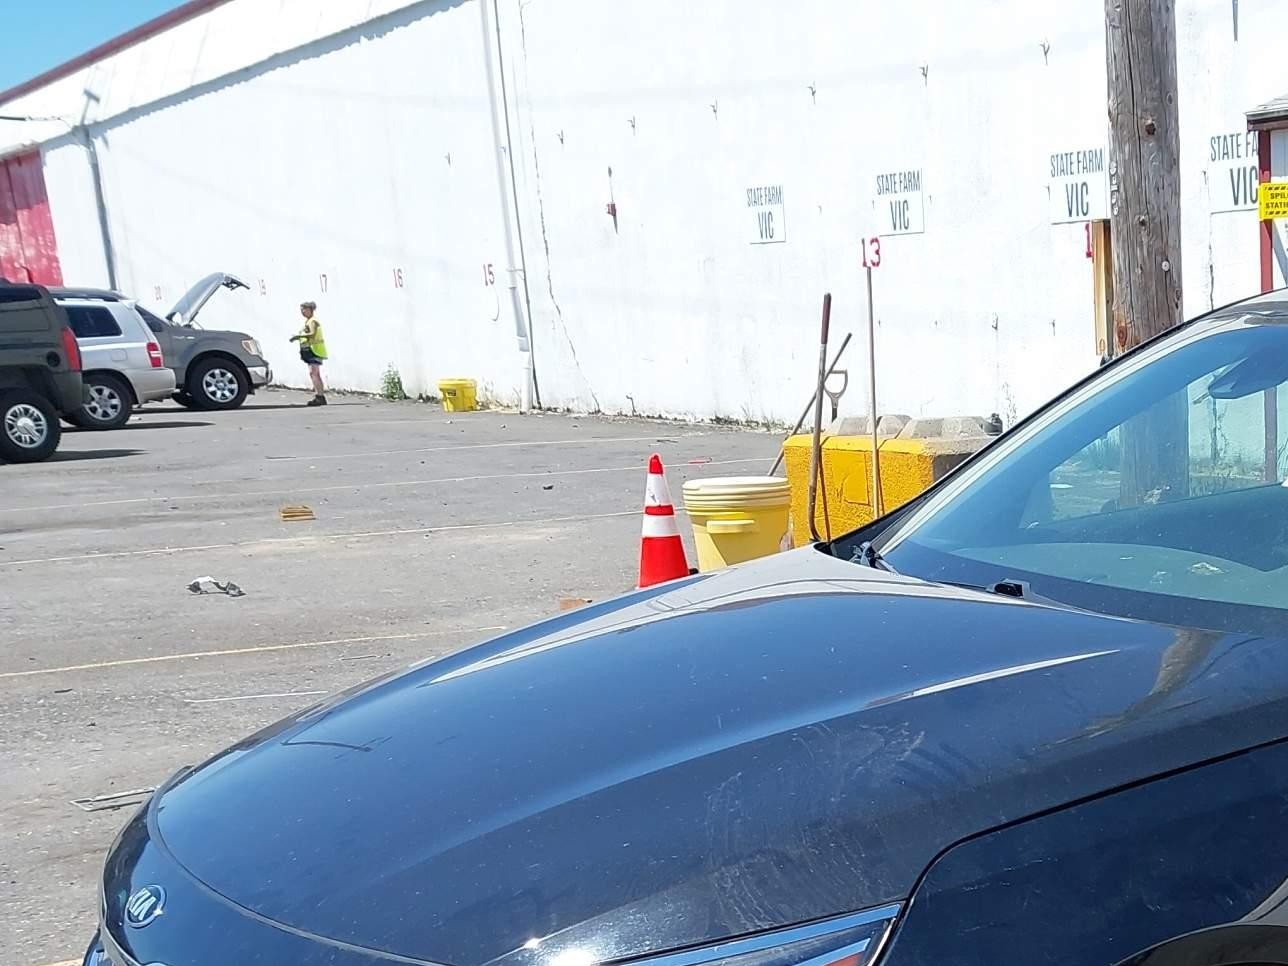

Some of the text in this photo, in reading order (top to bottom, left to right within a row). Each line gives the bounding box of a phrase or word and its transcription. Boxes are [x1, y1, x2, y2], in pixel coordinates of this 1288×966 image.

[1210, 131, 1259, 162] STATE FA
[1050, 147, 1104, 178] STATE FARM
[746, 185, 783, 207] STATE FARM
[876, 170, 921, 196] STATE FARM
[1229, 165, 1259, 206] VIC
[890, 199, 910, 231] VIC
[1065, 181, 1090, 218] VIC
[757, 211, 775, 240] VIC
[1084, 223, 1093, 258] 1
[861, 237, 881, 268] 13
[319, 273, 328, 293] 17
[392, 267, 404, 288] 16
[482, 263, 495, 286] 15
